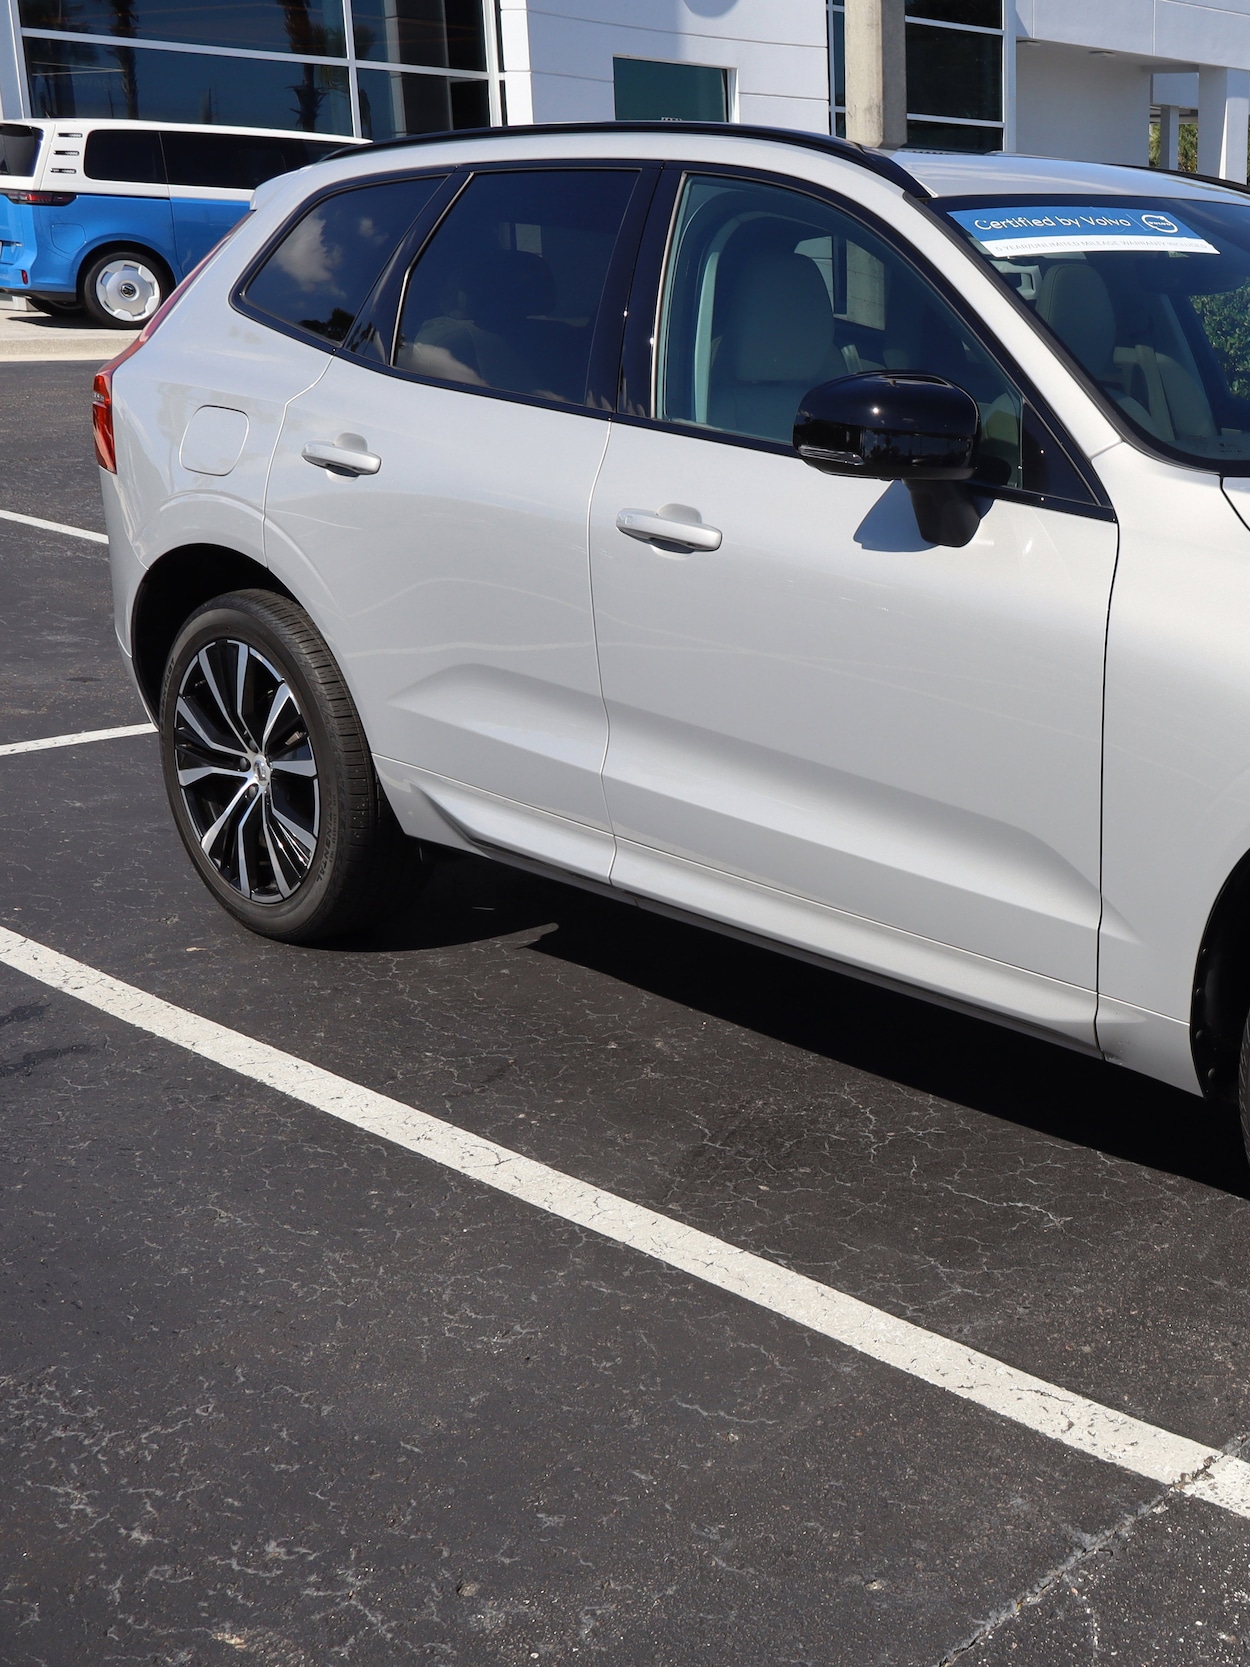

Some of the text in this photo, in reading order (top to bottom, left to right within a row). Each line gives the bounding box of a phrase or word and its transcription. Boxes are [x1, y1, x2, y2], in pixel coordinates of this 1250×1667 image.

[974, 215, 1131, 231] Certified by Volvo
